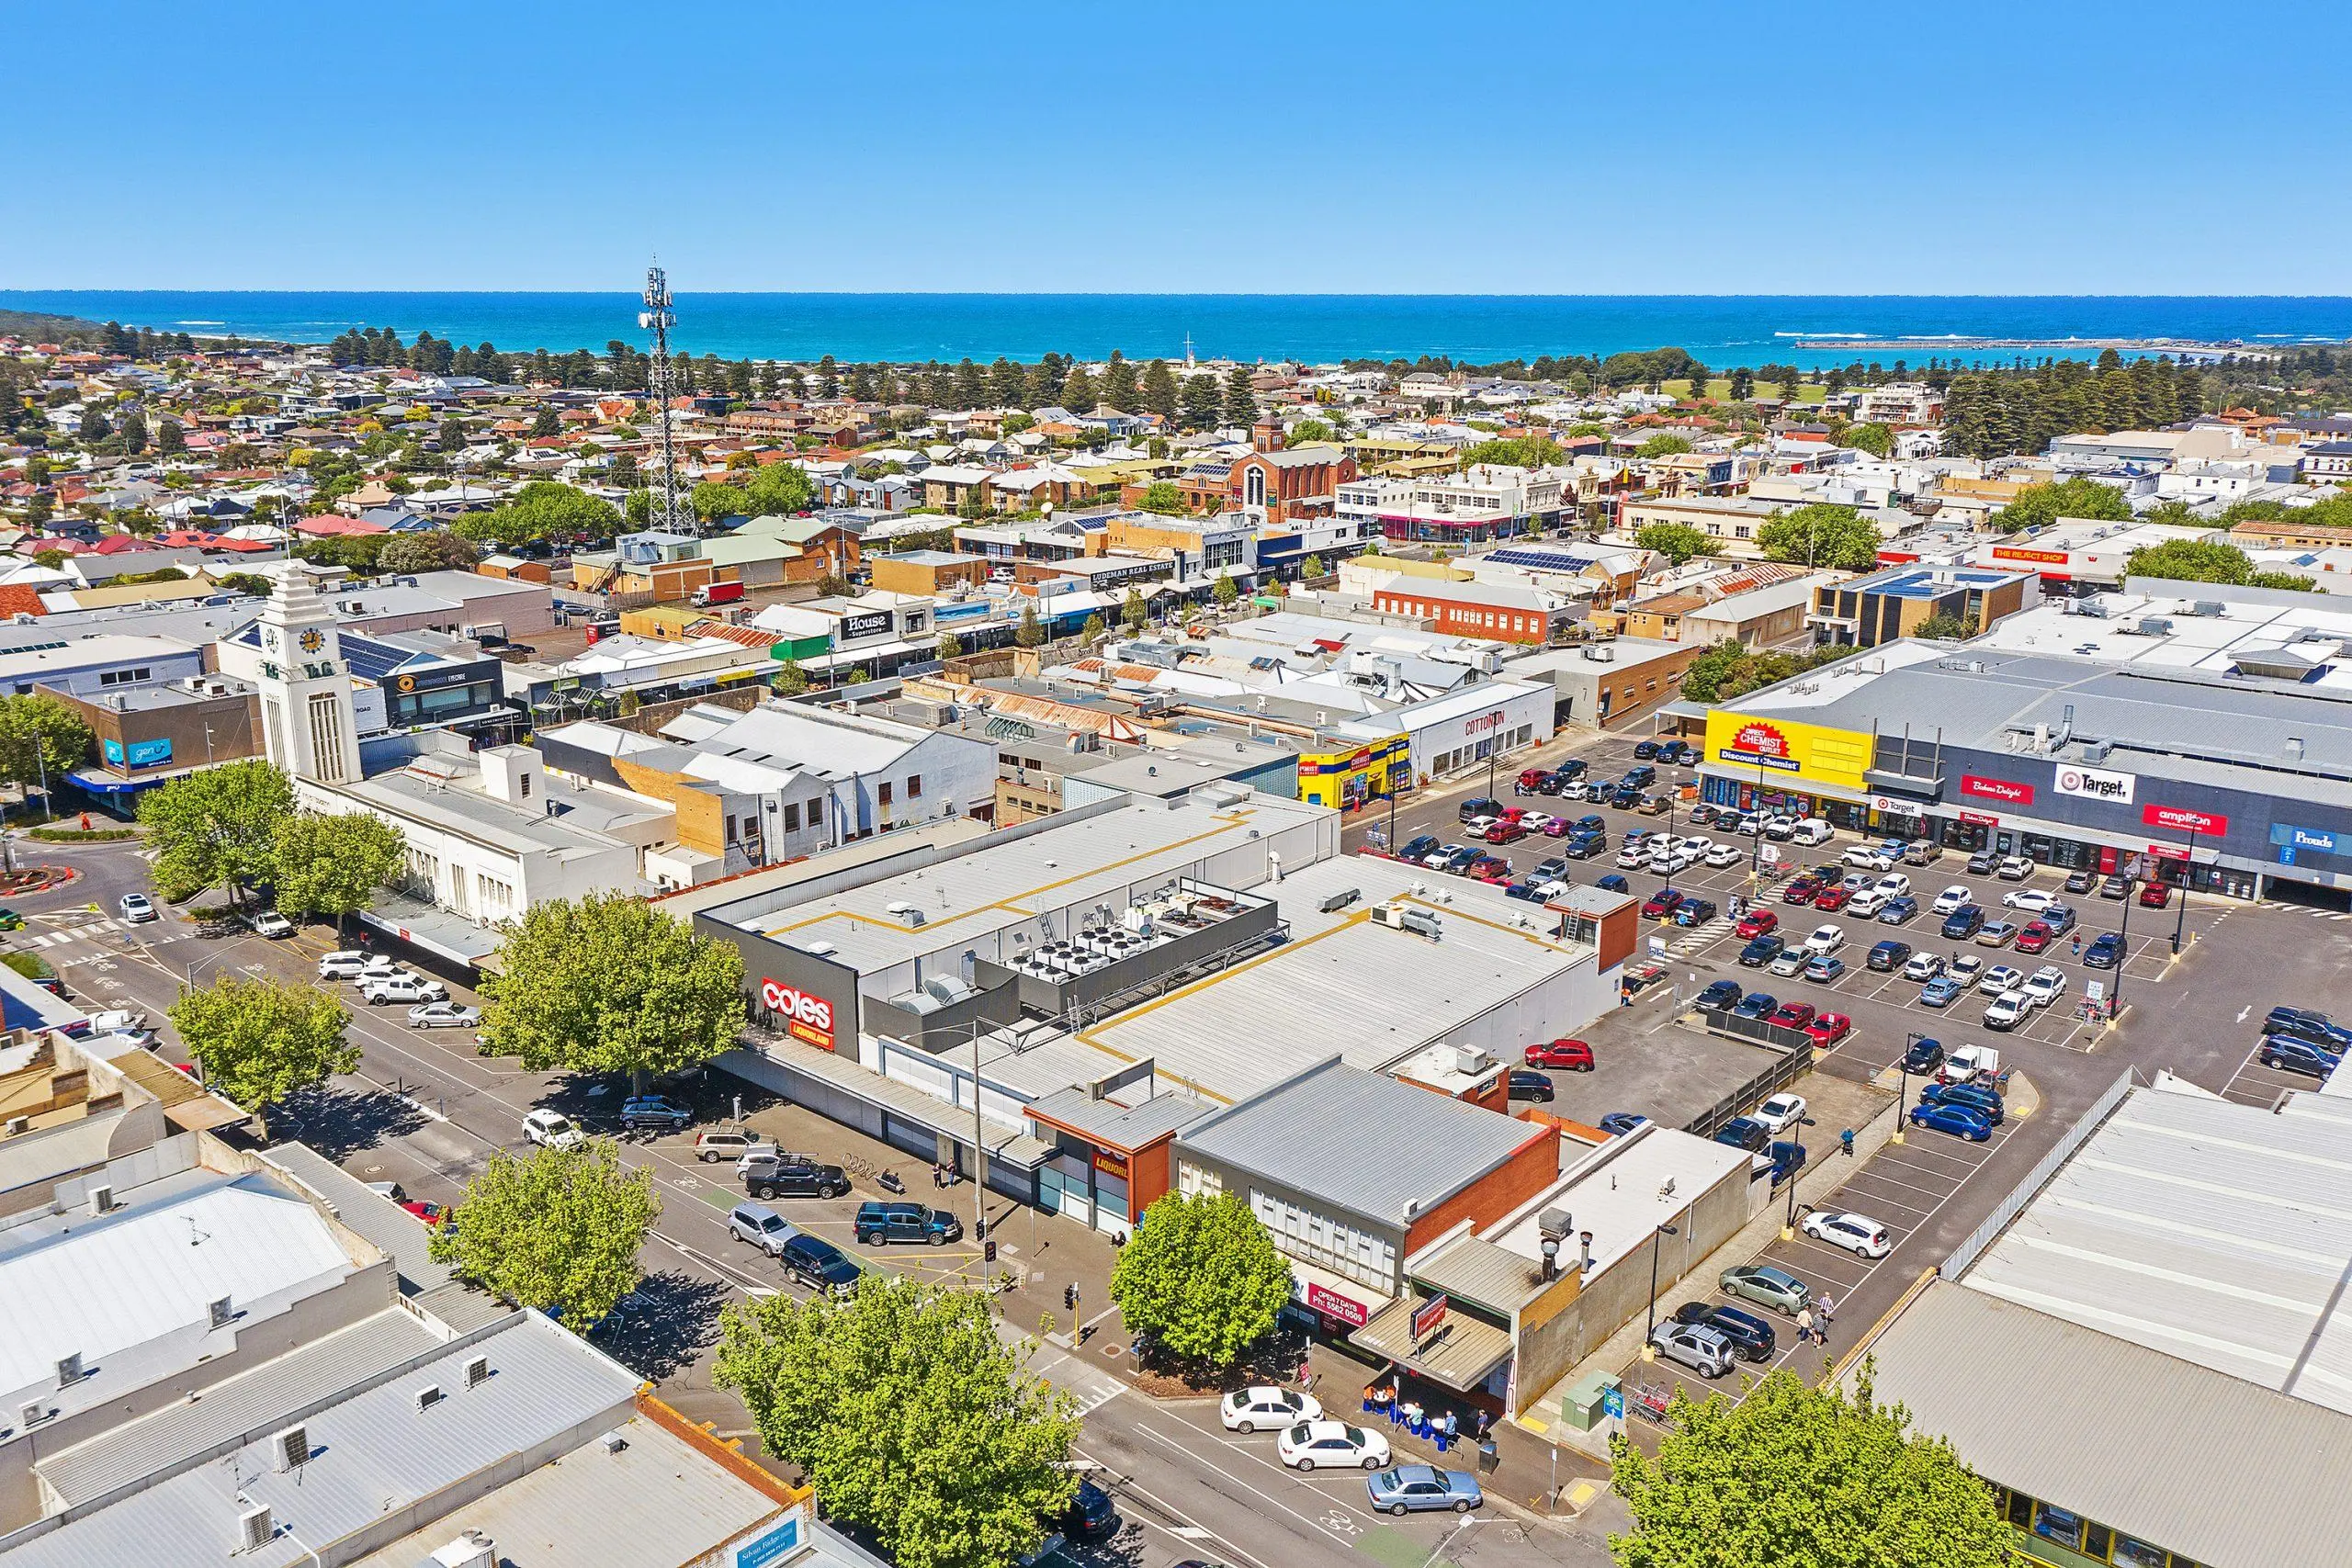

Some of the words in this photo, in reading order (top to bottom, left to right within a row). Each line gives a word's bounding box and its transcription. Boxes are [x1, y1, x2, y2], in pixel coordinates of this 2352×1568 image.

[2012, 551, 2041, 560] REJECT
[1092, 570, 1127, 581] LUDEMAN
[1129, 566, 1148, 575] REAL
[1149, 562, 1173, 571] ESTATE
[848, 615, 886, 631] House
[852, 627, 882, 637] Superstore
[1464, 712, 1495, 736] COTTON
[1740, 733, 1781, 748] CHEMIST
[1758, 746, 1781, 754] OUTLET
[1351, 754, 1370, 766] CHEMIST
[1721, 750, 1759, 763] Discount
[1760, 756, 1797, 770] Chemist
[1973, 781, 1996, 793] Bakers
[1996, 784, 2022, 798] Delight
[1890, 801, 1915, 813] Target
[2294, 830, 2334, 848] Prouds
[763, 983, 831, 1029] coles
[793, 1024, 830, 1046] LIQUORLAND
[1096, 1157, 1128, 1179] LIQUORL
[1313, 1295, 1325, 1306] Ph:
[1317, 1291, 1335, 1303] OPEN
[1340, 1300, 1357, 1312] DAYS
